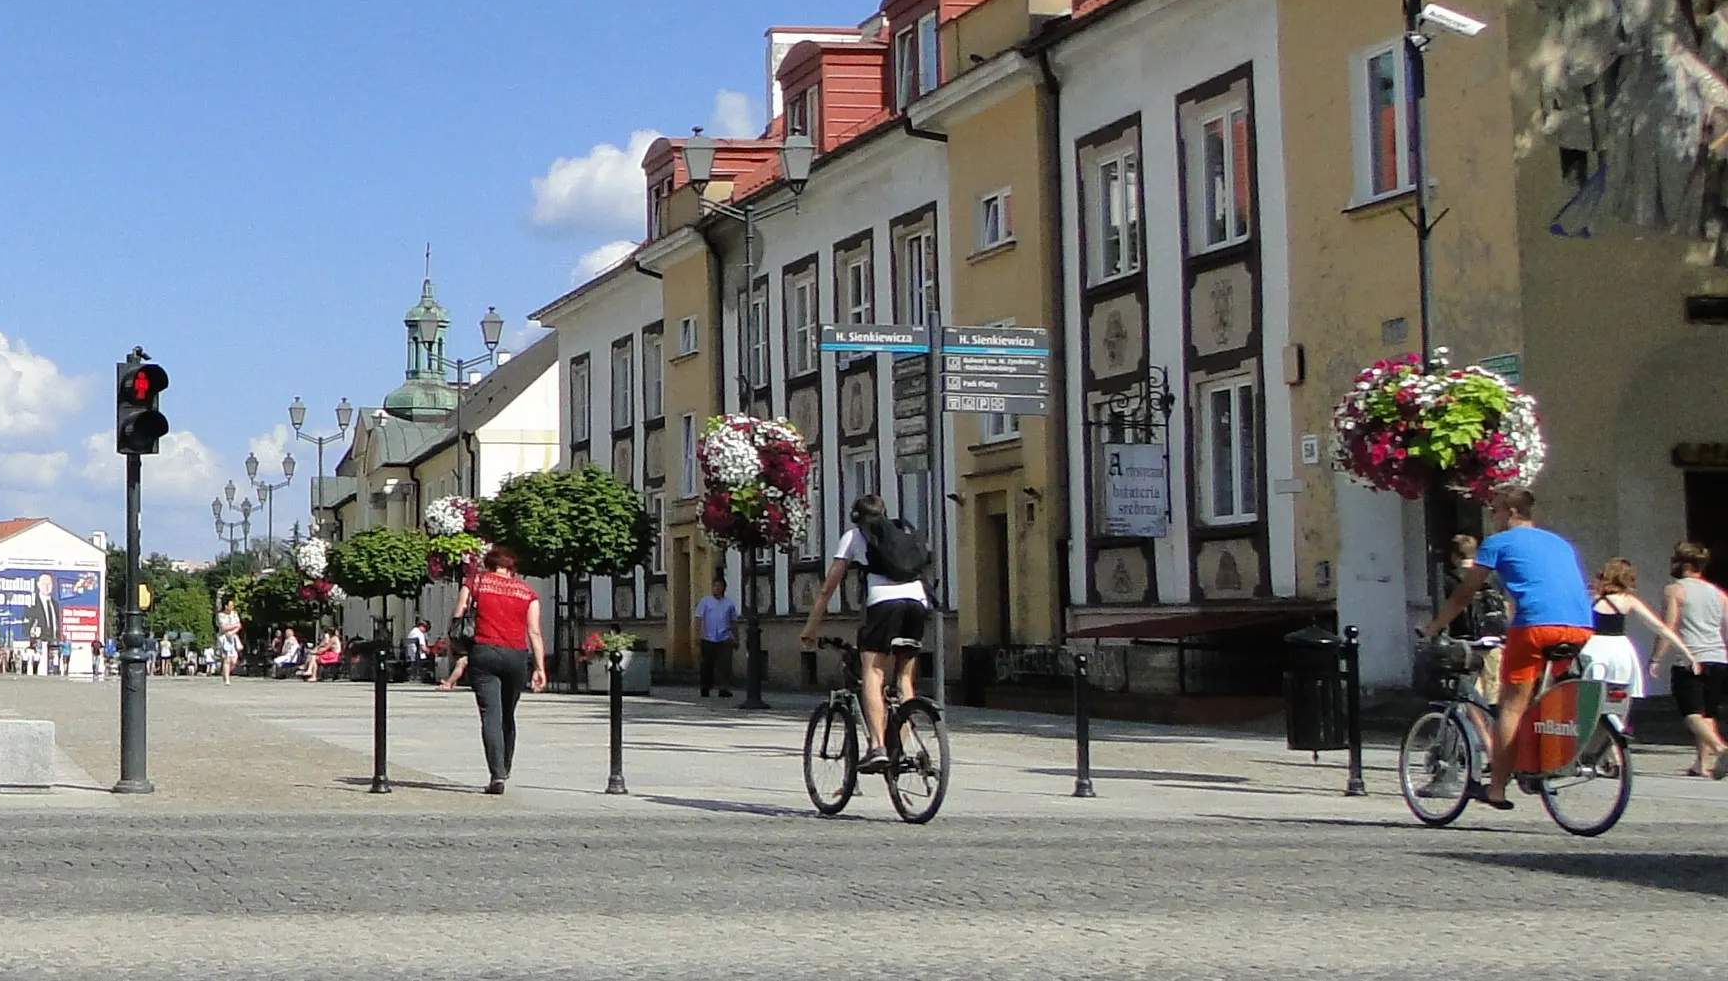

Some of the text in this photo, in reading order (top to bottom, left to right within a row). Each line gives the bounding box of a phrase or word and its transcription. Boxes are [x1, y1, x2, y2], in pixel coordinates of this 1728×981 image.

[835, 331, 913, 343] H. Sienkiewicza
[958, 334, 1035, 347] H. Sienkiewicza
[962, 380, 999, 390] Park Planty
[1533, 719, 1580, 737] mBank
